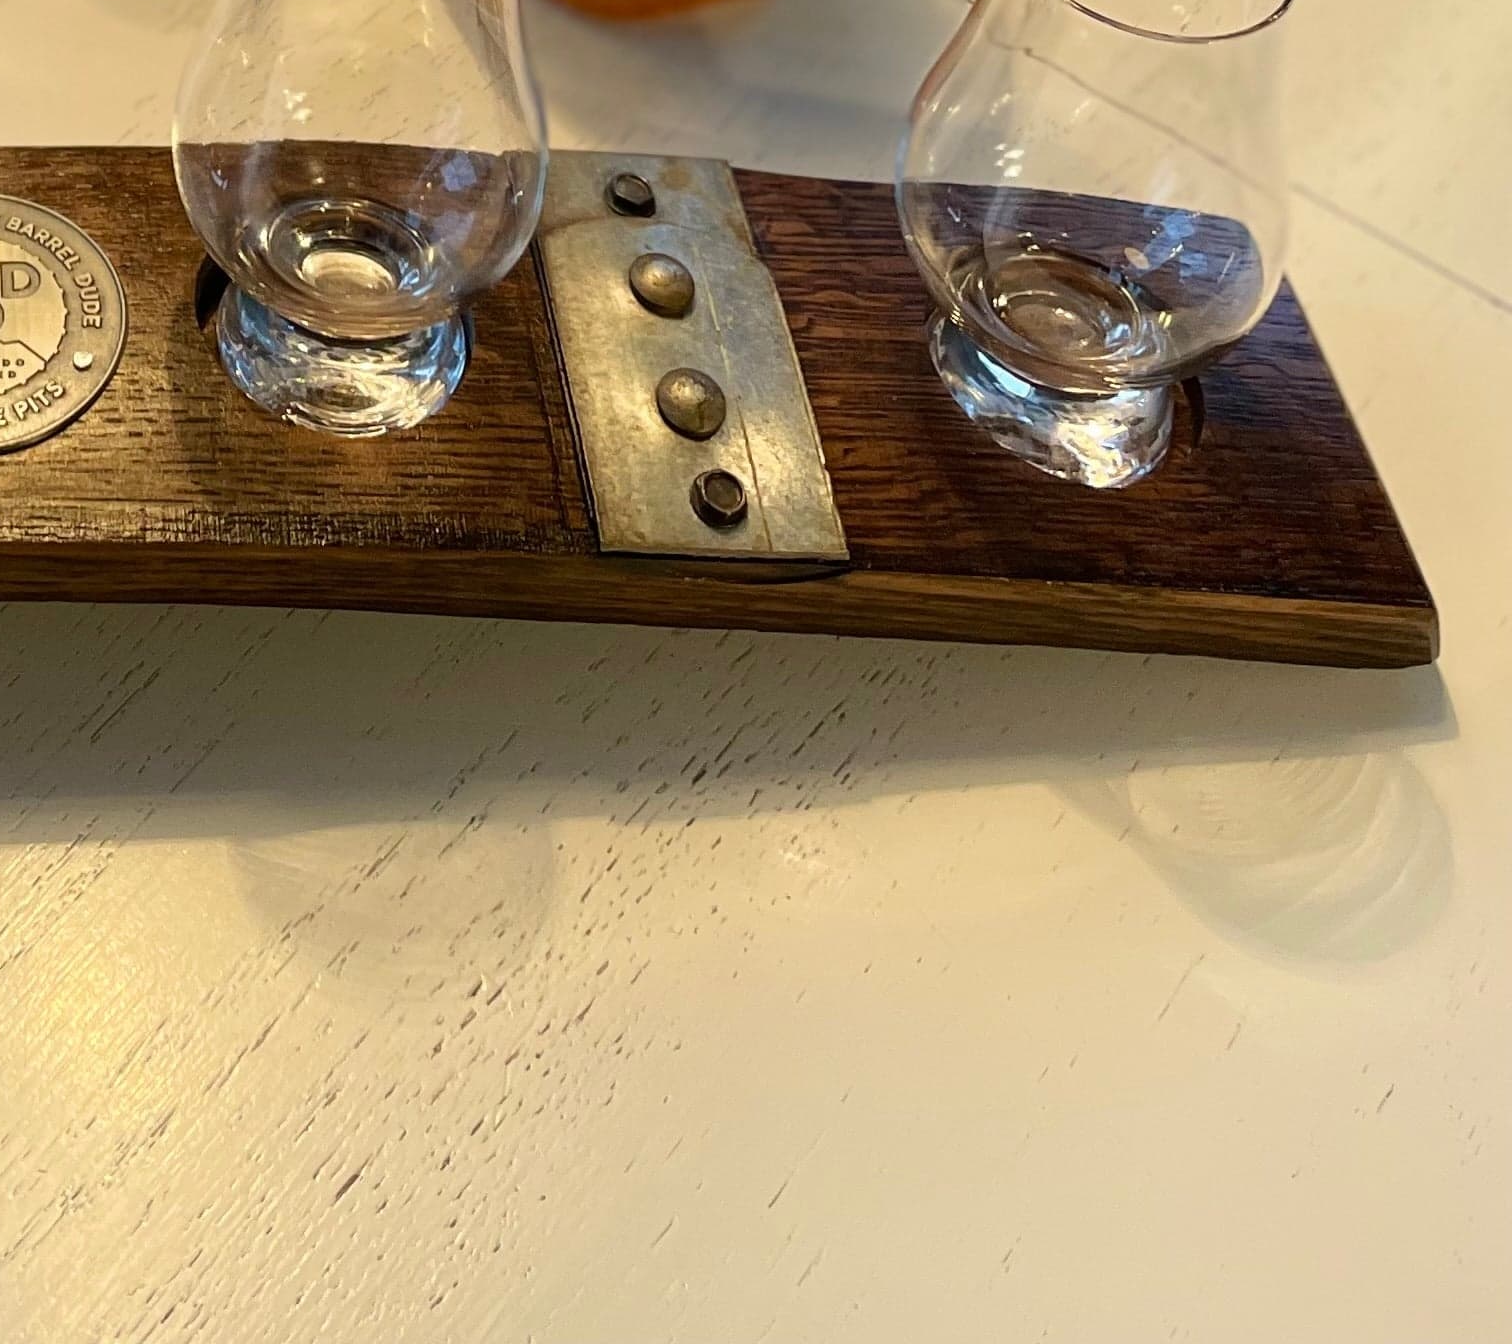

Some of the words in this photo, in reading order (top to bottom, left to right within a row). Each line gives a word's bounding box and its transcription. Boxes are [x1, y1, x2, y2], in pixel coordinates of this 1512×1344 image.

[6, 215, 82, 271] BARREL
[74, 272, 103, 329] DUDE
[16, 379, 66, 421] PITS
